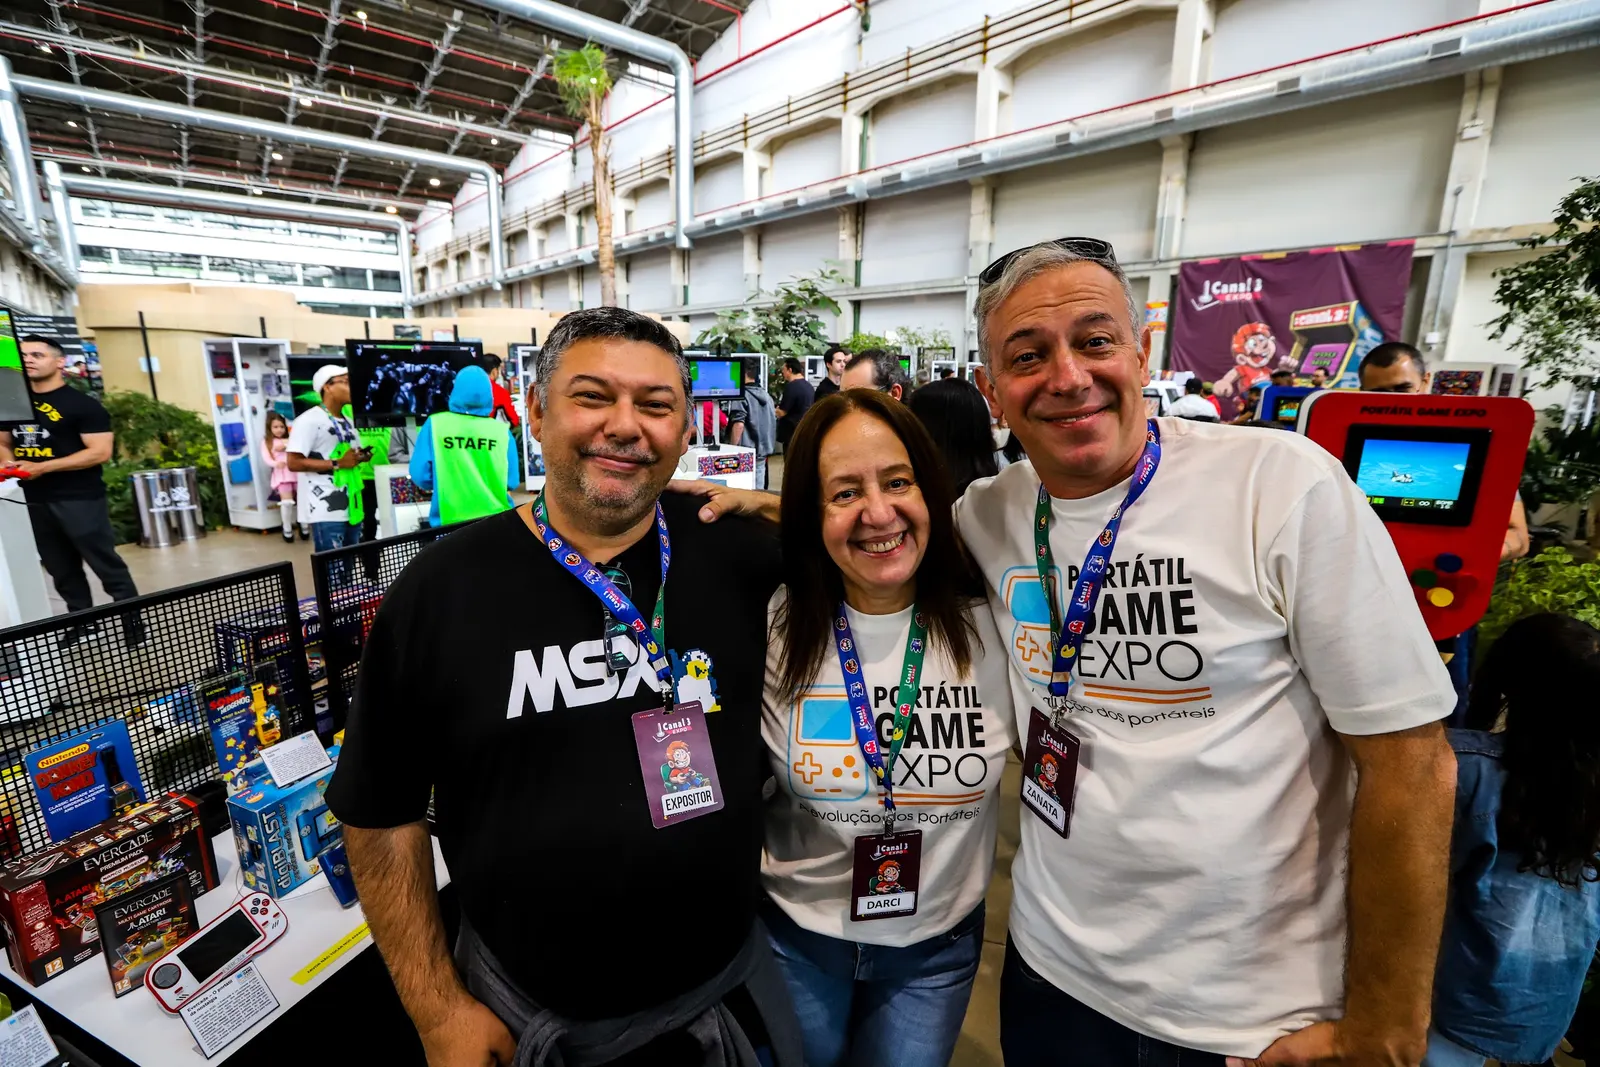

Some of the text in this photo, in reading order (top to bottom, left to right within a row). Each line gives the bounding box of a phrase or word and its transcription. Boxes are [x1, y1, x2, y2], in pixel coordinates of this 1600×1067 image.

[1211, 277, 1263, 295] Canal 3
[1225, 292, 1252, 301] EXPO
[1360, 404, 1487, 417] PORTÁTIL GAME EXPO
[14, 447, 53, 458] GYM
[443, 436, 497, 451] STAFF
[1068, 553, 1193, 590] PRTÁTIL
[1086, 590, 1198, 636] AME
[1078, 640, 1203, 682] EXPO
[506, 634, 663, 720] MSX
[209, 690, 246, 710] SONIC
[220, 695, 251, 715] HEDGEHOG
[663, 717, 692, 732] Canal 3
[1097, 706, 1125, 723] dos
[1128, 706, 1216, 728] portáteis
[672, 727, 688, 735] EXPO
[875, 712, 986, 749] GAME
[1046, 734, 1063, 752] Canal
[41, 745, 87, 767] Nintendo
[34, 752, 98, 789] DONKEY
[48, 799, 69, 812] CLASSIC
[69, 791, 89, 802] ARCADE
[50, 806, 63, 815] WITH
[665, 790, 713, 811] EXPOSITOR
[1026, 784, 1059, 820] ZANATA
[811, 809, 881, 826] evolução
[84, 830, 154, 871] EVERCADE
[262, 811, 292, 889] digiBLAST
[881, 843, 903, 853] Canal
[100, 847, 145, 873] PREMIUM PACK
[64, 883, 92, 901] ATARI
[114, 886, 173, 919] EVERCADE
[866, 898, 901, 910] DARCI
[117, 915, 134, 926] MULTI
[133, 908, 148, 919] GAME
[138, 908, 167, 927] ATARI
[46, 959, 62, 975] 12
[116, 979, 130, 991] 12
[187, 996, 209, 1013] Evercade
[217, 979, 234, 993] portátil
[189, 996, 218, 1017] da nostalgia
